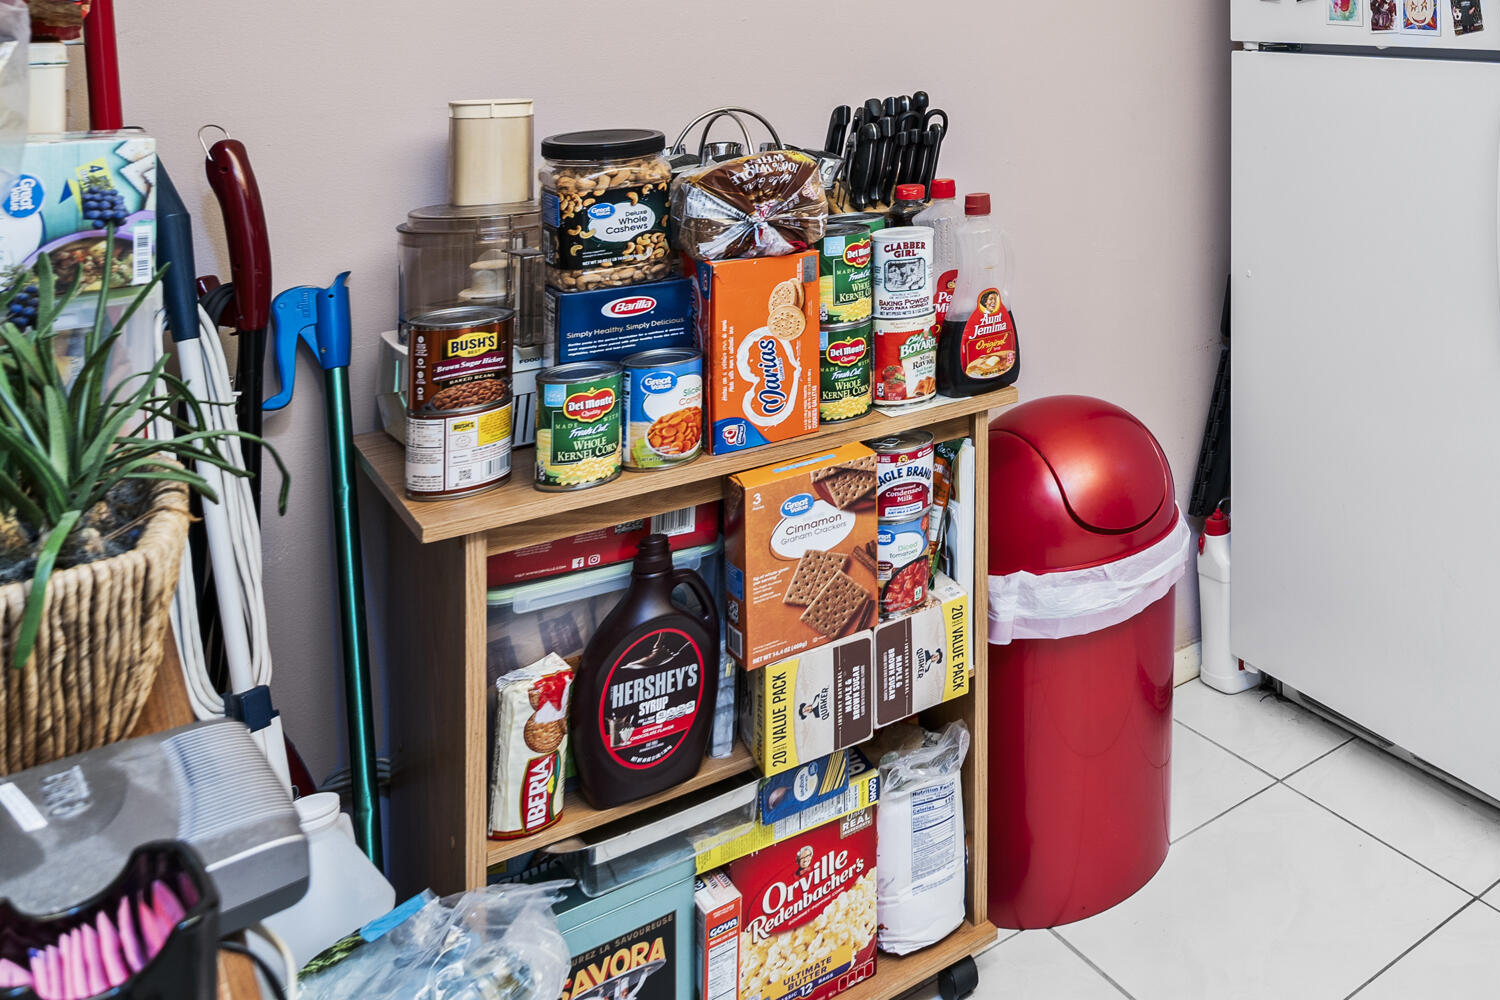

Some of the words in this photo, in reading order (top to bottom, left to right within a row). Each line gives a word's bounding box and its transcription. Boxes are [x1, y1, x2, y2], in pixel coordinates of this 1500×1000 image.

[19, 177, 37, 211] Great
[591, 206, 611, 214] Great
[625, 209, 648, 217] Deluxe
[605, 223, 648, 235] Cashews
[618, 215, 648, 226] Whole
[846, 251, 858, 259] Del
[884, 241, 926, 254] CLABBER
[893, 249, 917, 258] GIRL
[614, 297, 653, 313] Barilla
[839, 291, 866, 303] KERNEL
[879, 299, 903, 307] BAKING
[904, 295, 930, 306] POWDER
[980, 312, 1003, 326] Aunt
[566, 330, 593, 340] Simply
[625, 321, 650, 331] Simply
[968, 321, 1007, 340] Jemima
[451, 335, 495, 354] BUSH'S
[829, 348, 843, 357] Del
[843, 344, 865, 355] Monte
[975, 333, 1009, 354] Original
[437, 363, 460, 373] Brown
[460, 359, 482, 368] Sugar
[519, 356, 542, 365] FOOD
[645, 376, 672, 387] Great
[759, 339, 786, 414] Marias
[834, 378, 862, 391] WHOLE
[650, 383, 673, 391] Value
[822, 388, 852, 400] KERNEL
[852, 382, 870, 396] CORN
[568, 400, 585, 412] Del
[585, 394, 613, 410] Monte
[581, 408, 602, 418] Quality
[555, 422, 579, 430] MADE
[568, 425, 592, 439] Fresh
[557, 448, 595, 463] KERNEL
[595, 441, 617, 458] CORN
[573, 436, 608, 451] WHOLE
[878, 467, 904, 488] AGLE
[906, 465, 932, 481] BRAND
[752, 492, 762, 505] 3
[885, 485, 923, 498] Condensed
[896, 494, 913, 503] Milk
[784, 497, 809, 511] Great
[780, 531, 813, 546] Graham
[814, 521, 848, 536] Crackers
[785, 513, 843, 536] Cinnamon
[951, 604, 964, 619] 20
[951, 625, 964, 662] VALUE
[888, 647, 896, 676] BROWN
[895, 655, 903, 681] MAPLE
[916, 647, 924, 679] QUAKER
[612, 663, 699, 710] HERSHEY'S
[852, 665, 860, 692] SUGAR
[952, 662, 965, 692] PACK
[772, 671, 787, 705] PACK
[888, 676, 896, 701] SUGAR
[638, 695, 669, 717] SYRUP
[820, 687, 831, 721] QUAKER
[845, 686, 853, 713] MAPLE
[852, 691, 860, 721] BROWN
[772, 704, 787, 745] VALUE
[772, 750, 788, 768] 20
[526, 756, 552, 830] IBERIA
[868, 778, 877, 803] GOYA
[912, 786, 939, 798] Nutrition
[939, 781, 955, 791] Facts
[912, 805, 935, 815] Calories
[842, 813, 871, 832] REAL
[762, 849, 849, 915] Orville
[745, 857, 865, 944] Redenbacher's
[599, 943, 612, 956] LA
[614, 914, 674, 948] SAVOUREUSE
[709, 917, 738, 939] GOYA
[783, 955, 832, 986] ULTIMATE
[787, 965, 828, 992] BUTTER
[799, 982, 813, 997] 12
[818, 972, 834, 985] BAGS
